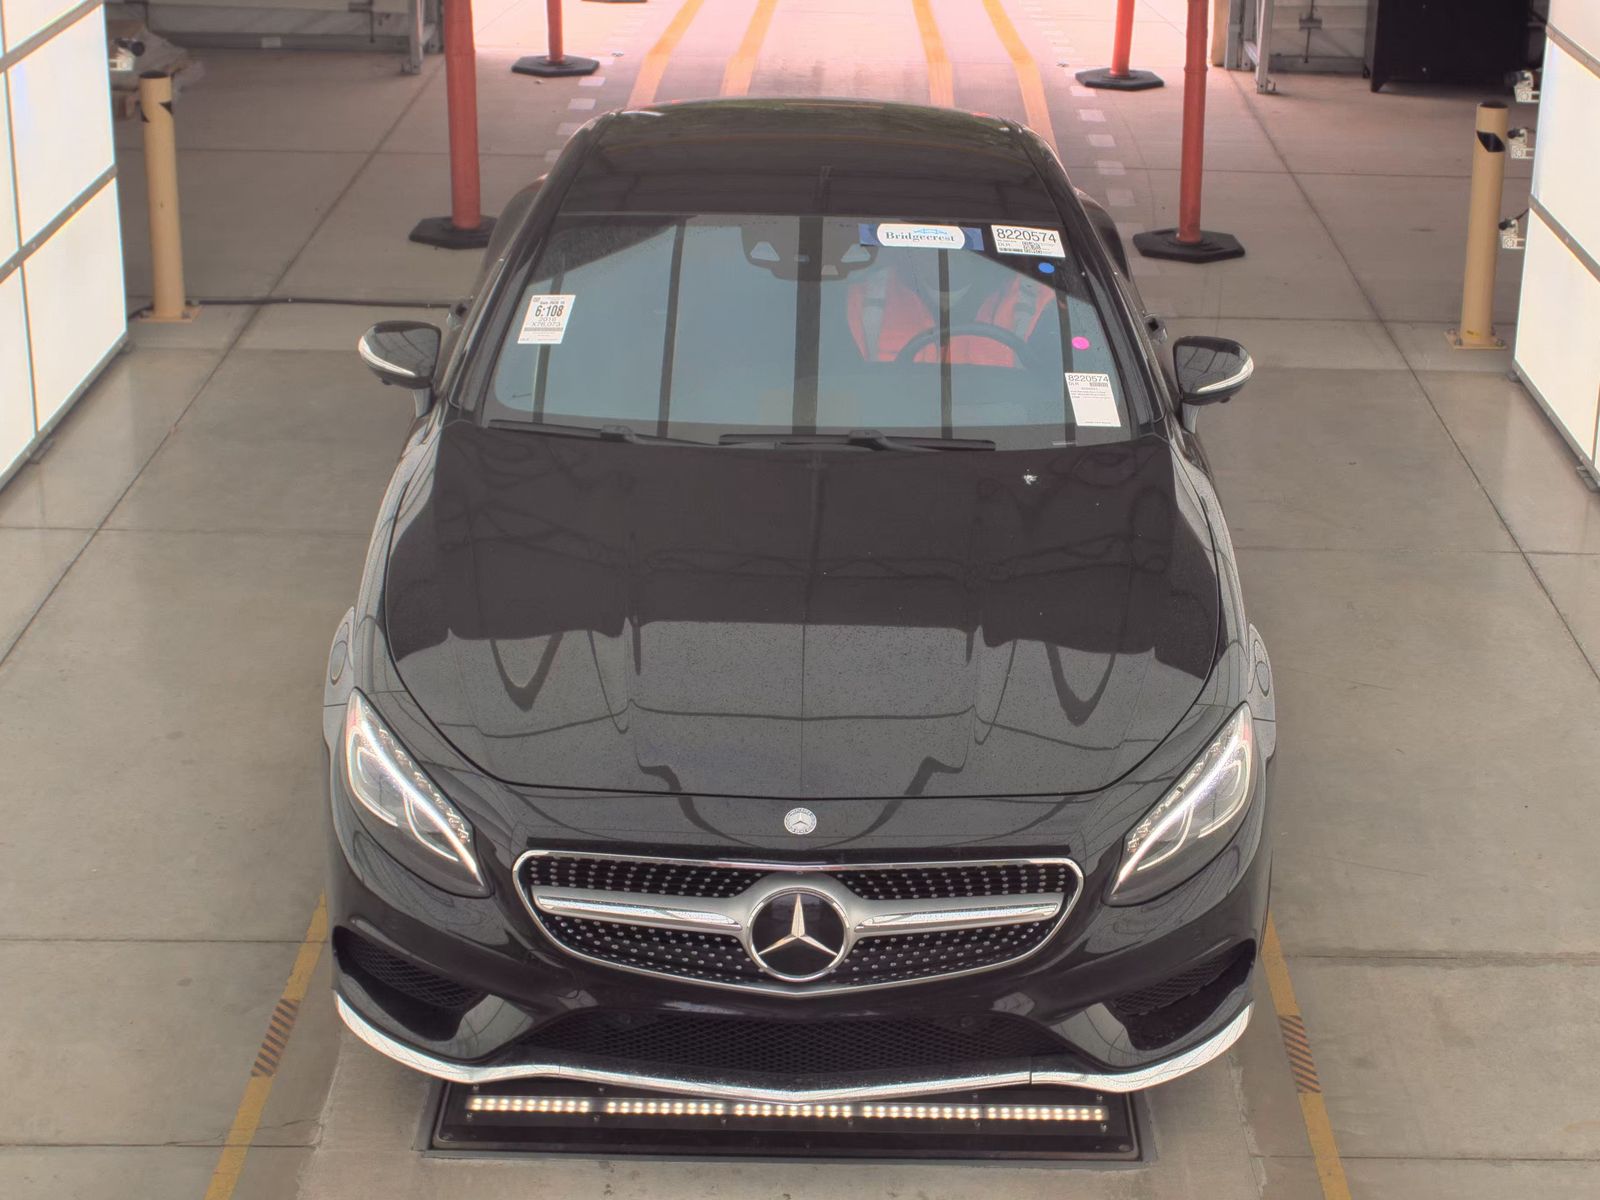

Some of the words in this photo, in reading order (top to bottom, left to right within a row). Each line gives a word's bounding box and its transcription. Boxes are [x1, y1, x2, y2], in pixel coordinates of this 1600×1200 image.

[885, 231, 955, 242] Bridgecrest
[996, 228, 1057, 243] 8220574
[535, 305, 564, 317] 6:108
[1068, 374, 1109, 382] 8220574
